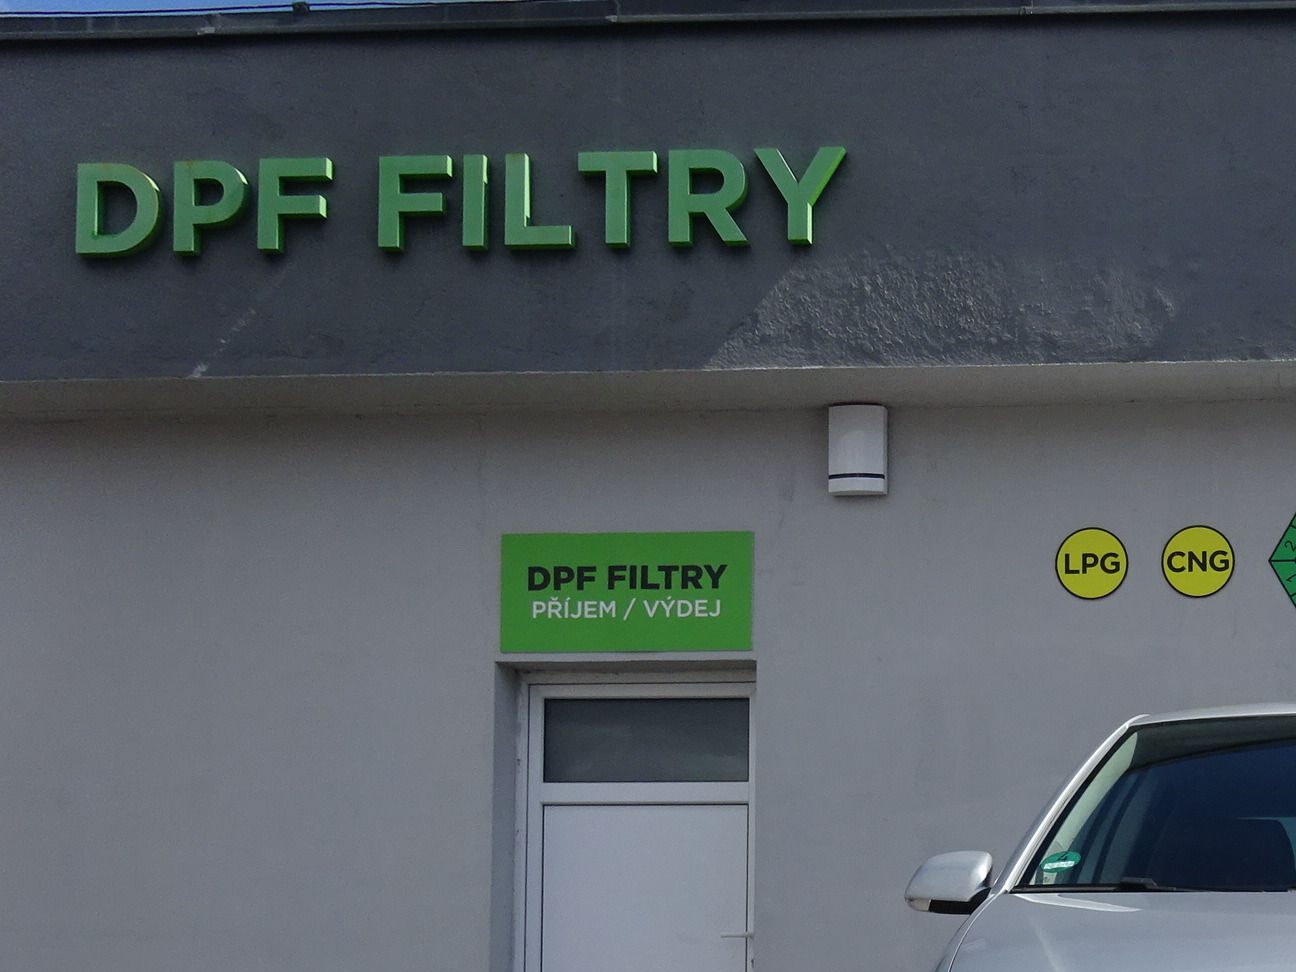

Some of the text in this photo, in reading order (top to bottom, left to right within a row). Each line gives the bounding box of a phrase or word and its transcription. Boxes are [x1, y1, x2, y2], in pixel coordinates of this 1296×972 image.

[75, 146, 848, 256] DPF FILTRY
[1064, 552, 1121, 575] LPG
[1166, 550, 1230, 573] CNG
[527, 564, 728, 591] DPF FILTRY
[532, 597, 616, 619] PŘÍJEM
[643, 596, 721, 618] VÝDEJ
